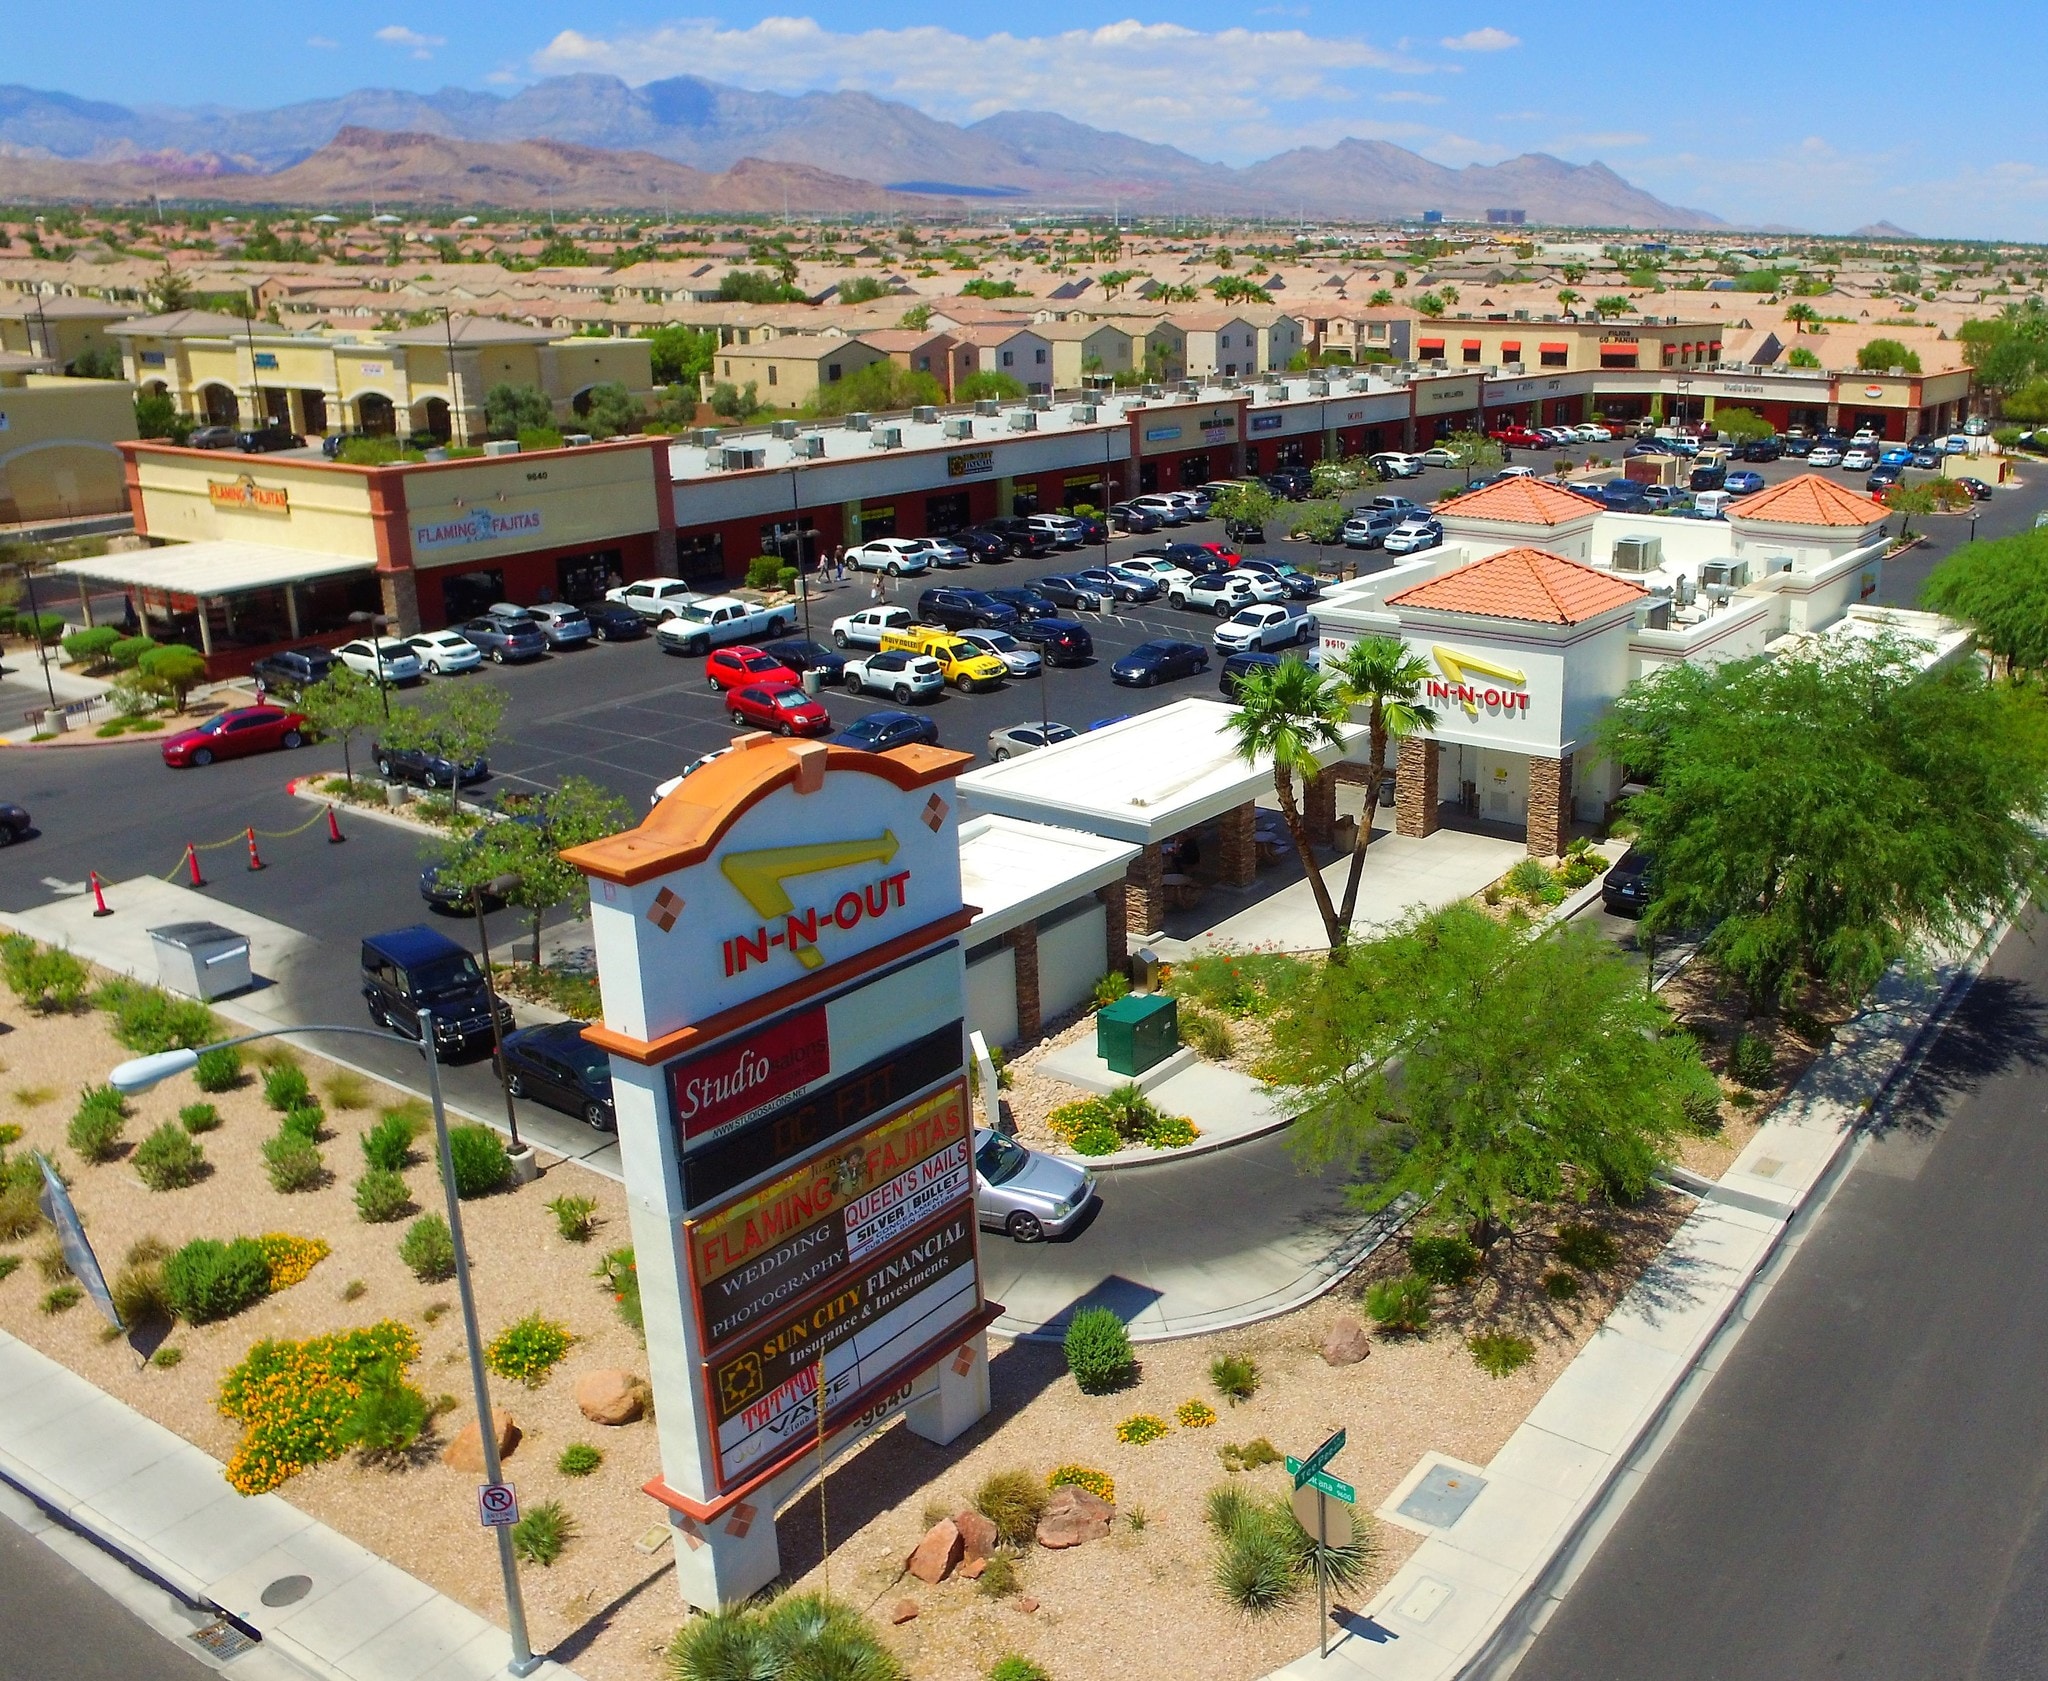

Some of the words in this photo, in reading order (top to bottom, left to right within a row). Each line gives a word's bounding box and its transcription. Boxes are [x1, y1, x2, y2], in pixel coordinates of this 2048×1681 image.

[418, 522, 477, 543] FLAMING
[492, 513, 540, 532] FAJITAS
[1325, 638, 1346, 650] 9610
[1427, 680, 1529, 710] IN-N-OUT
[723, 870, 911, 978] IN-N-OUT
[681, 1049, 770, 1119] Studio
[702, 1176, 834, 1277] FLAMING
[866, 1105, 961, 1184] FAJITAS
[846, 1170, 918, 1228] QUEEN'S
[921, 1141, 967, 1183] NAILS
[857, 1206, 905, 1243] SILVER
[912, 1172, 960, 1209] BULLET
[875, 1193, 945, 1238] CONCEALMENT
[864, 1230, 898, 1252] CUSTOM
[918, 1193, 955, 1219] HOLSTERS
[712, 1249, 845, 1338] PHOTOGRAPHY
[721, 1224, 832, 1297] WEDDING
[763, 1319, 808, 1362] SUN
[812, 1286, 862, 1330] CITY
[866, 1222, 966, 1297] FINANCIAL
[789, 1316, 858, 1367] Insurance
[861, 1306, 872, 1320] &
[875, 1254, 950, 1311] Investments
